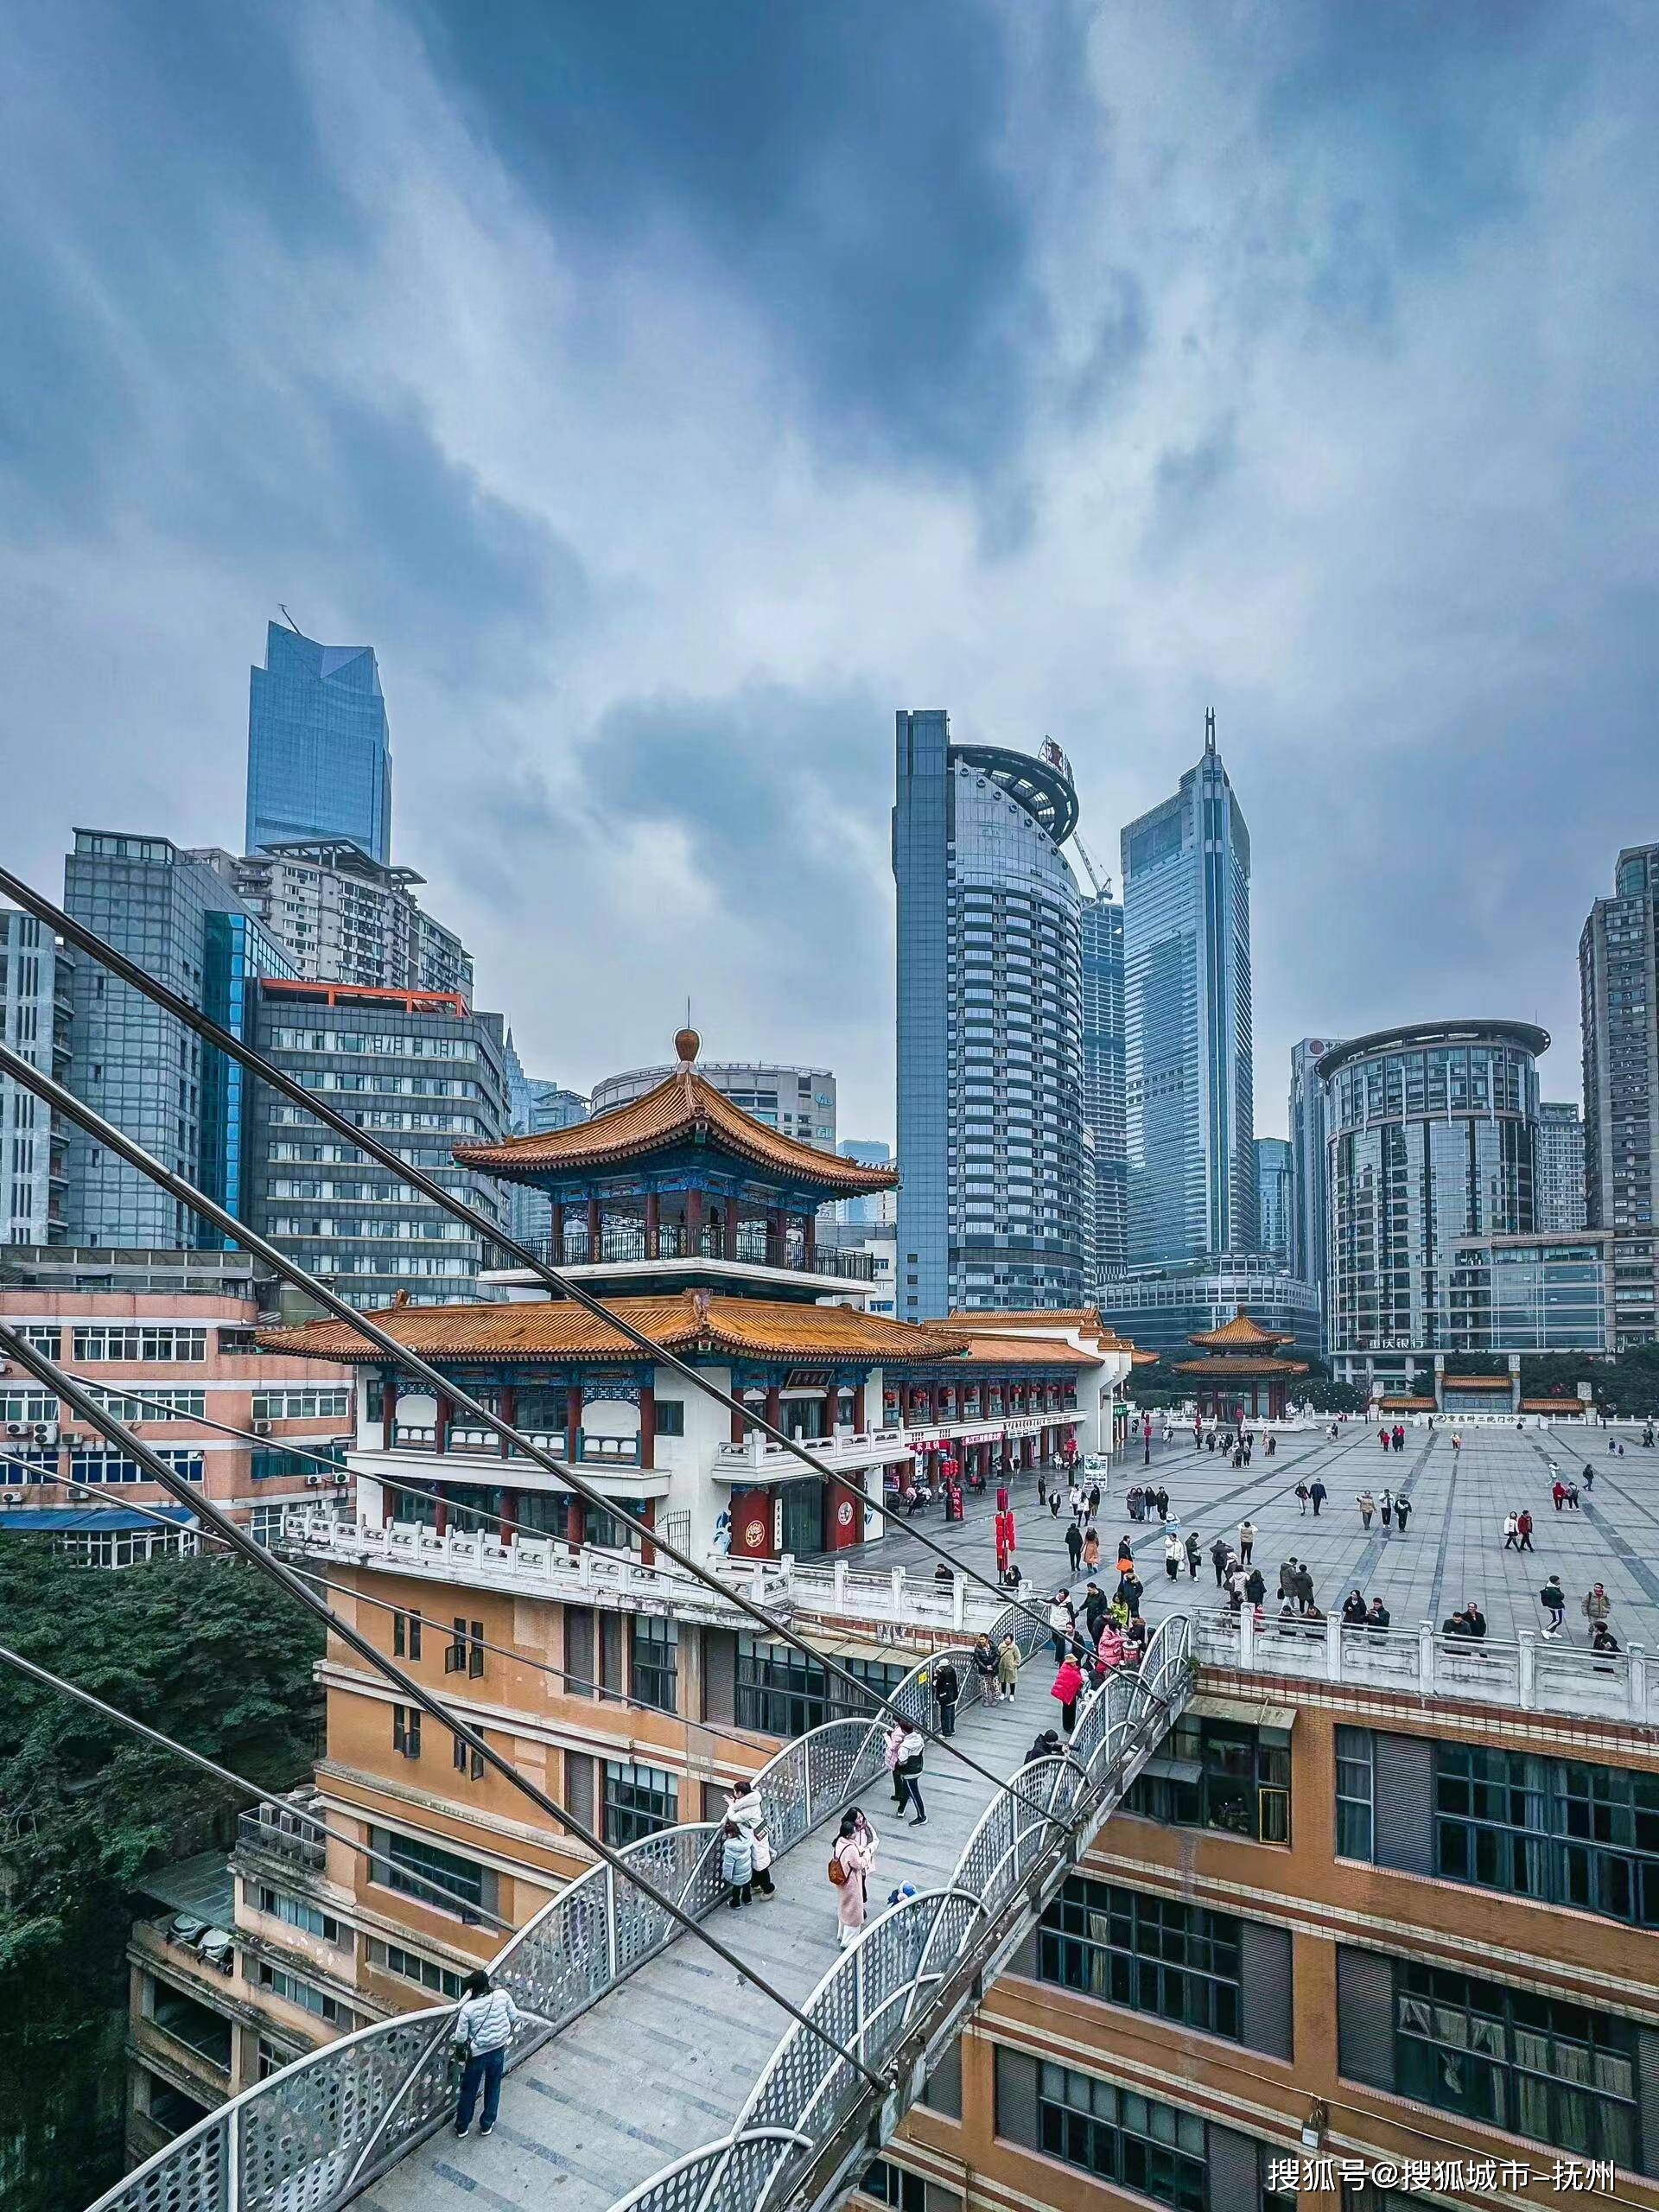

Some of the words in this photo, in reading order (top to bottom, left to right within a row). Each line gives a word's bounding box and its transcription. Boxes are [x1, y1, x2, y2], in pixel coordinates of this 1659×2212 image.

[1370, 1338, 1425, 1349] 重庆银行
[1447, 1415, 1527, 1424] 重医附二院门诊部
